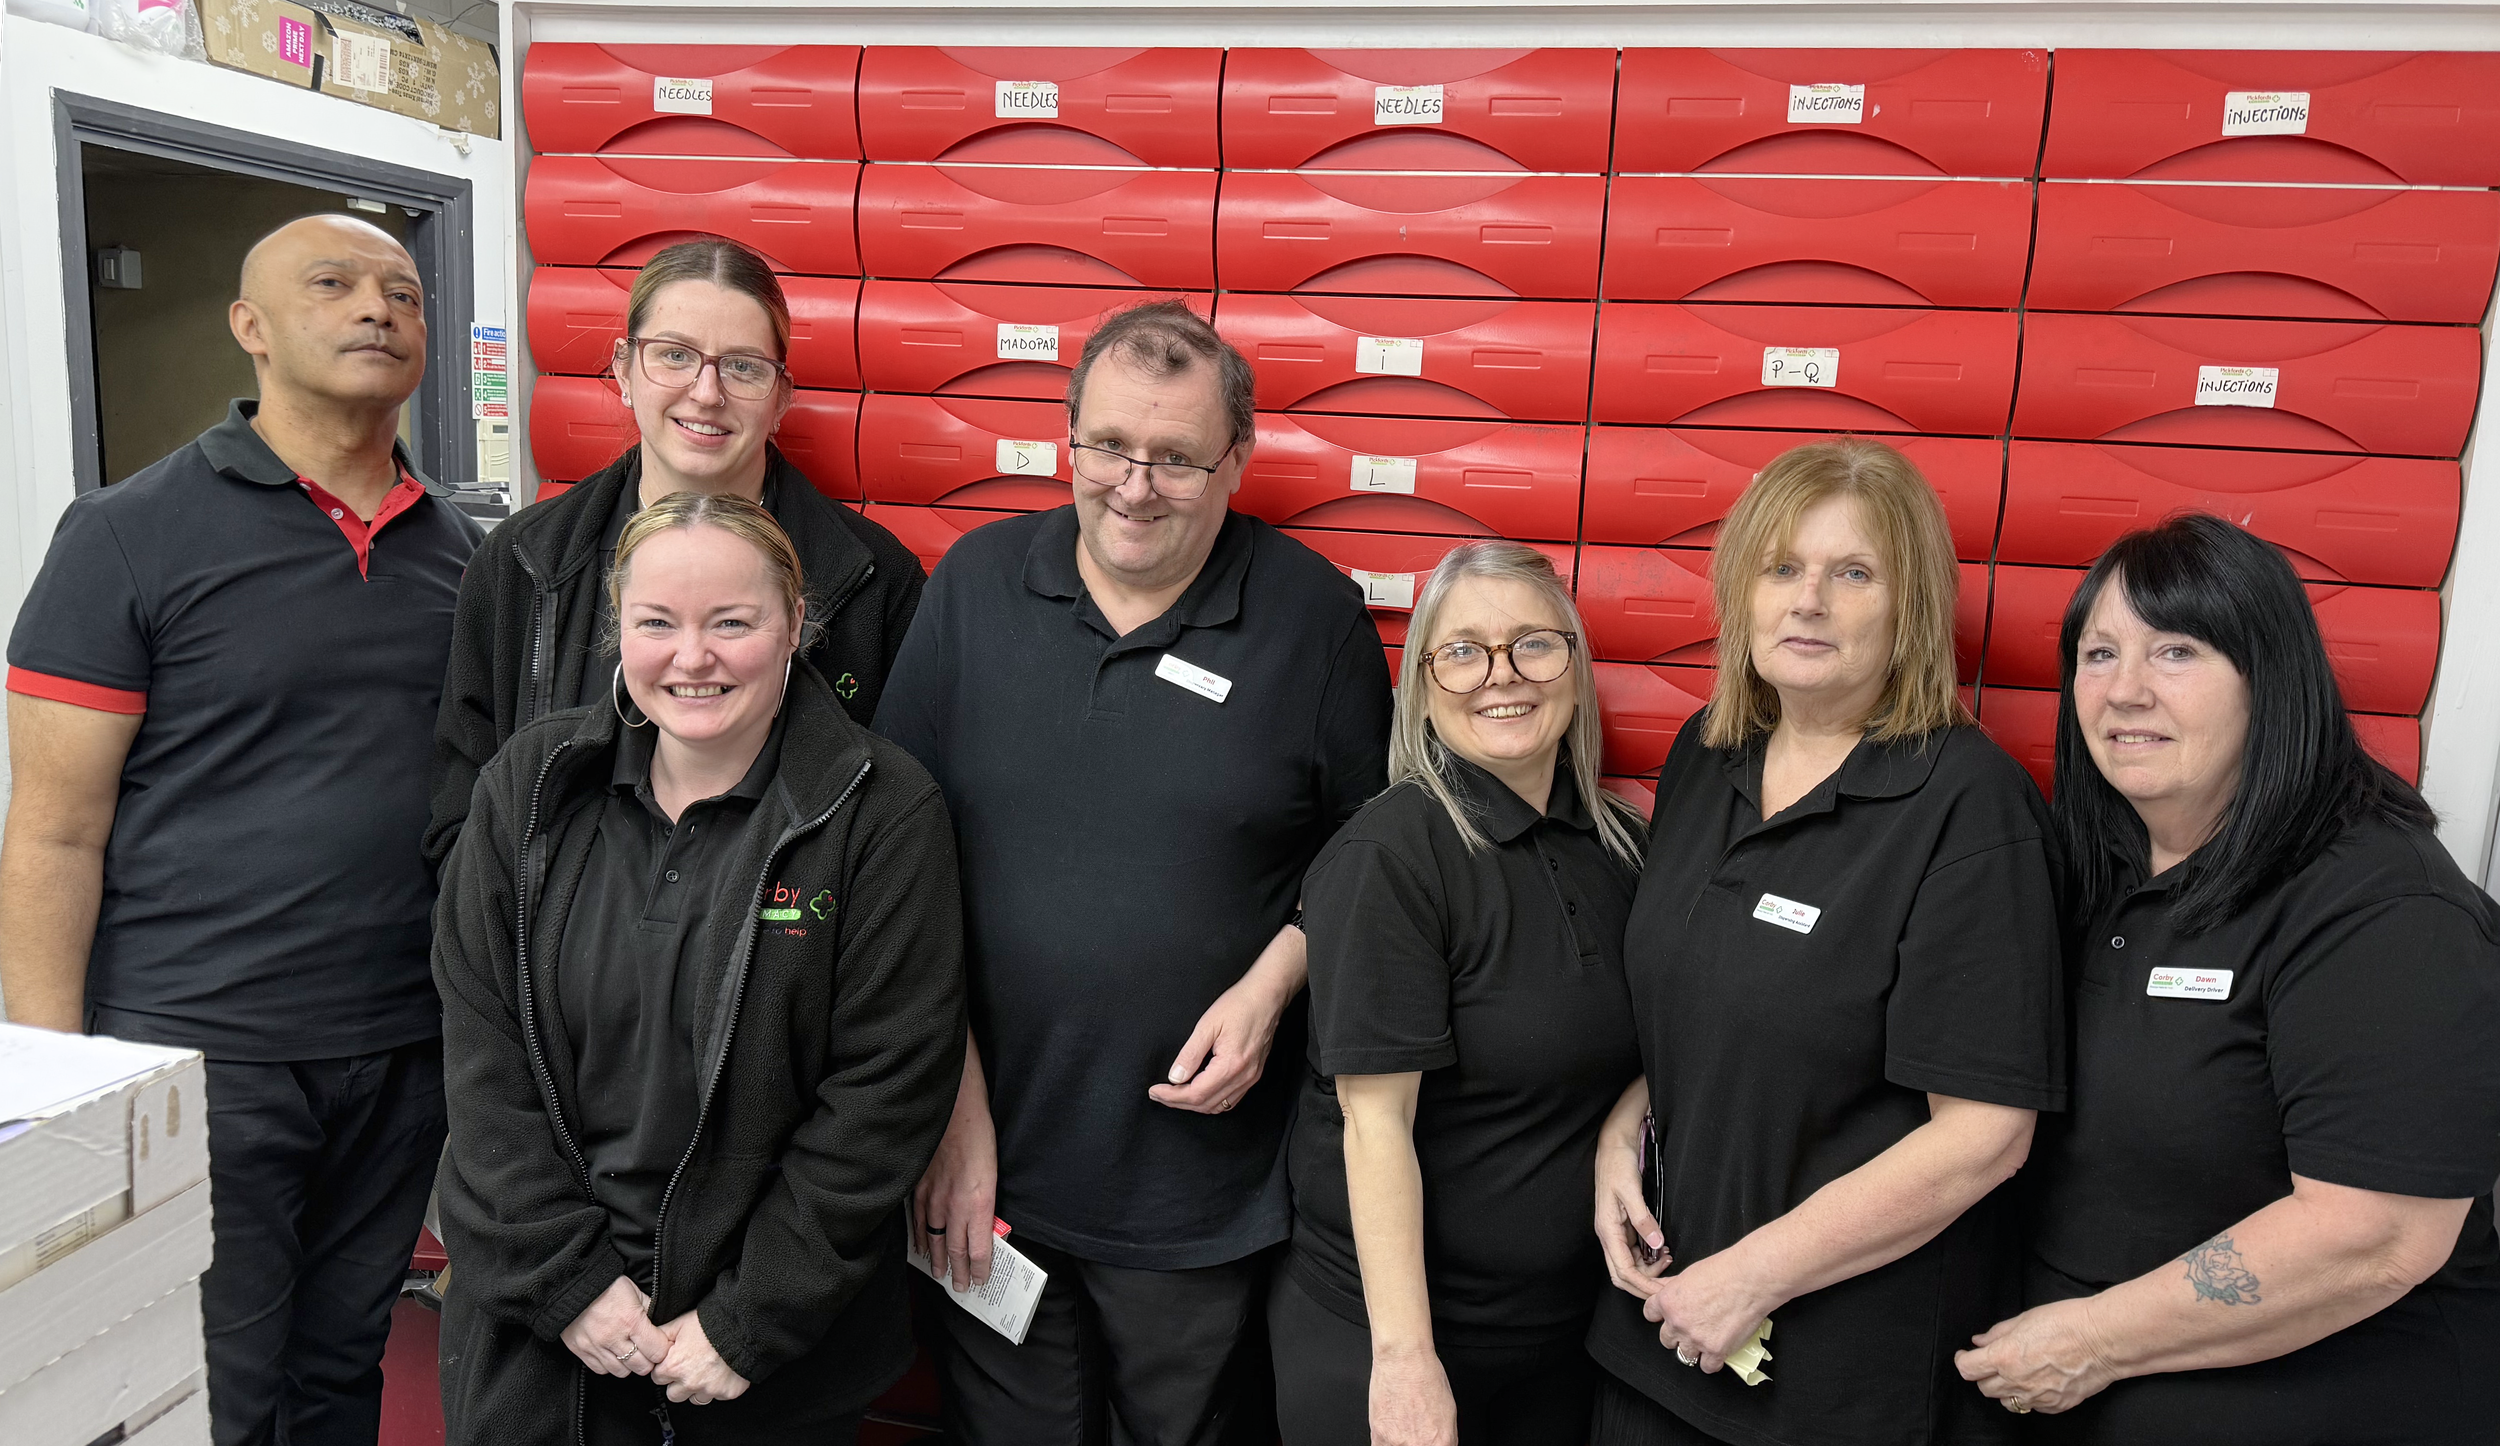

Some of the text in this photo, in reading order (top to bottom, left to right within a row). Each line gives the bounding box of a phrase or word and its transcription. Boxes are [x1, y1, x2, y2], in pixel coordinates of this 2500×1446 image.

[659, 86, 712, 101] NEEDLES
[1003, 91, 1058, 109] NEEDLES
[1376, 96, 1441, 115] NEEDLES
[1000, 338, 1057, 351] MADOPAR
[1016, 451, 1030, 469] D
[1369, 469, 1385, 486] L
[1369, 582, 1385, 600] L
[1203, 676, 1216, 685] Phil
[1792, 908, 1805, 917] Julie
[784, 926, 807, 937] help
[2153, 973, 2174, 982] Corby
